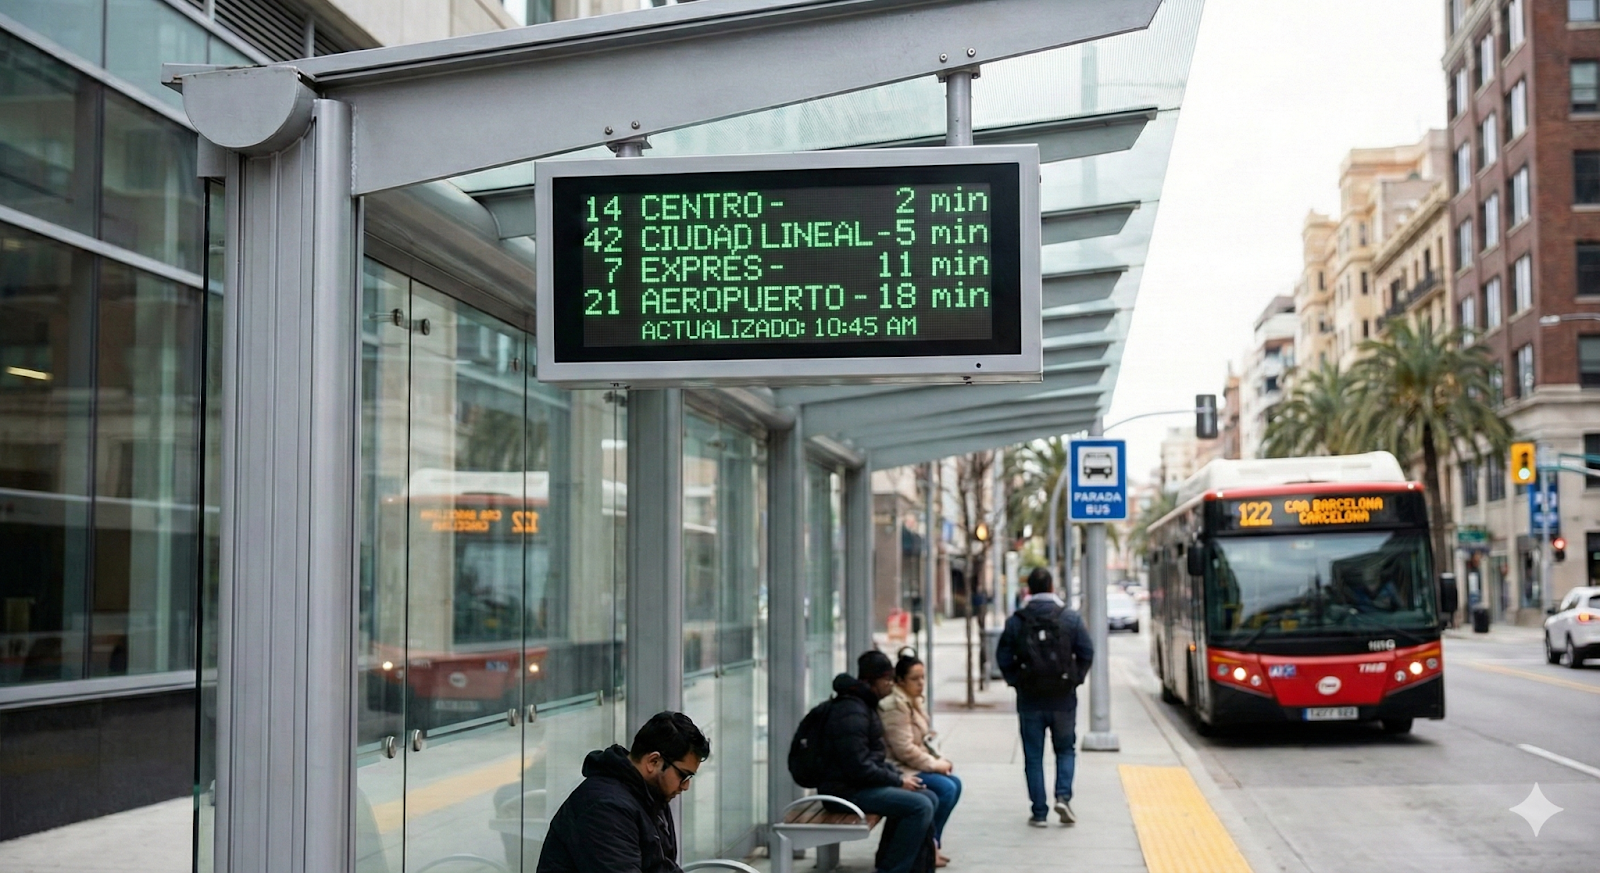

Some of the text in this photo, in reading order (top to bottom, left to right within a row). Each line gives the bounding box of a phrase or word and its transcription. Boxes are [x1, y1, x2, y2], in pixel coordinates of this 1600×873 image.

[586, 195, 622, 223] 14
[641, 191, 763, 221] CENTRO
[896, 187, 916, 214] 2
[931, 186, 988, 213] min
[583, 226, 623, 253] 42
[641, 224, 753, 252] CIUDAD
[761, 220, 874, 249] LINEAL
[931, 217, 988, 245] min
[604, 257, 623, 284] 7
[641, 248, 763, 283] EXPRÉS
[879, 250, 912, 278] 11
[931, 248, 989, 277] min
[584, 288, 620, 316] 21
[641, 284, 845, 315] AEROPUERTO
[879, 282, 916, 309] 18
[931, 280, 989, 309] min
[641, 315, 917, 340] ACTUALIZADO: 10:45 AM
[1074, 491, 1121, 502] PARADA
[1086, 504, 1110, 515] BUS
[1239, 501, 1273, 527] 122
[1312, 497, 1383, 512] BARCELONA
